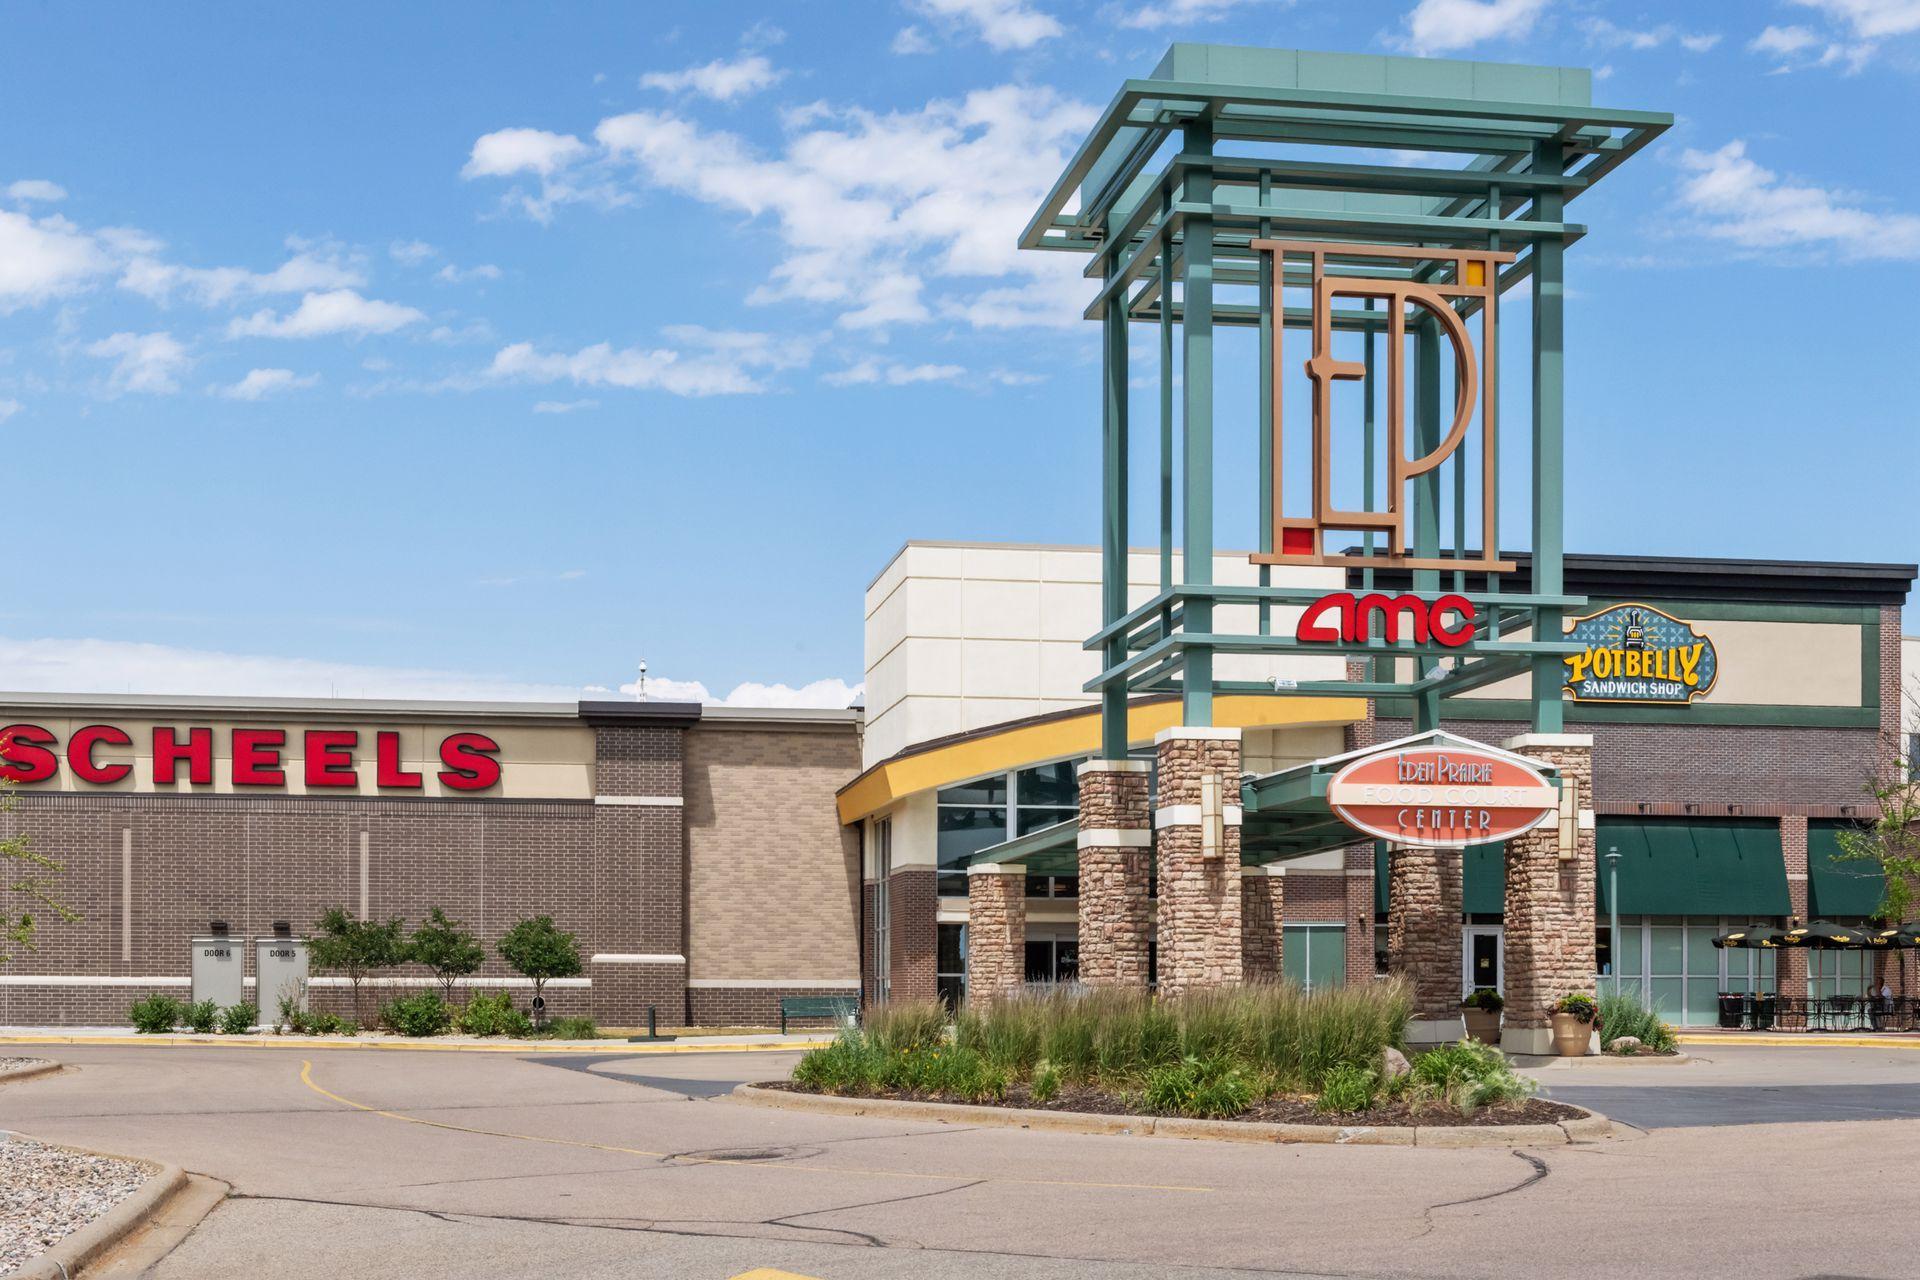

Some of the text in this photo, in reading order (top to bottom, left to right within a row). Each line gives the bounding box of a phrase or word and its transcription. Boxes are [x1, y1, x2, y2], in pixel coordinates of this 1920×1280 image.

[1563, 642, 1705, 686] POTBELLY
[1583, 680, 1683, 696] SANDWICH SHOP
[0, 723, 501, 791] SCHEELS
[1363, 786, 1528, 807] FOOD COURT
[1397, 808, 1492, 830] CENTER
[204, 949, 231, 957] DOOR 6
[269, 949, 297, 958] DOOR 5
